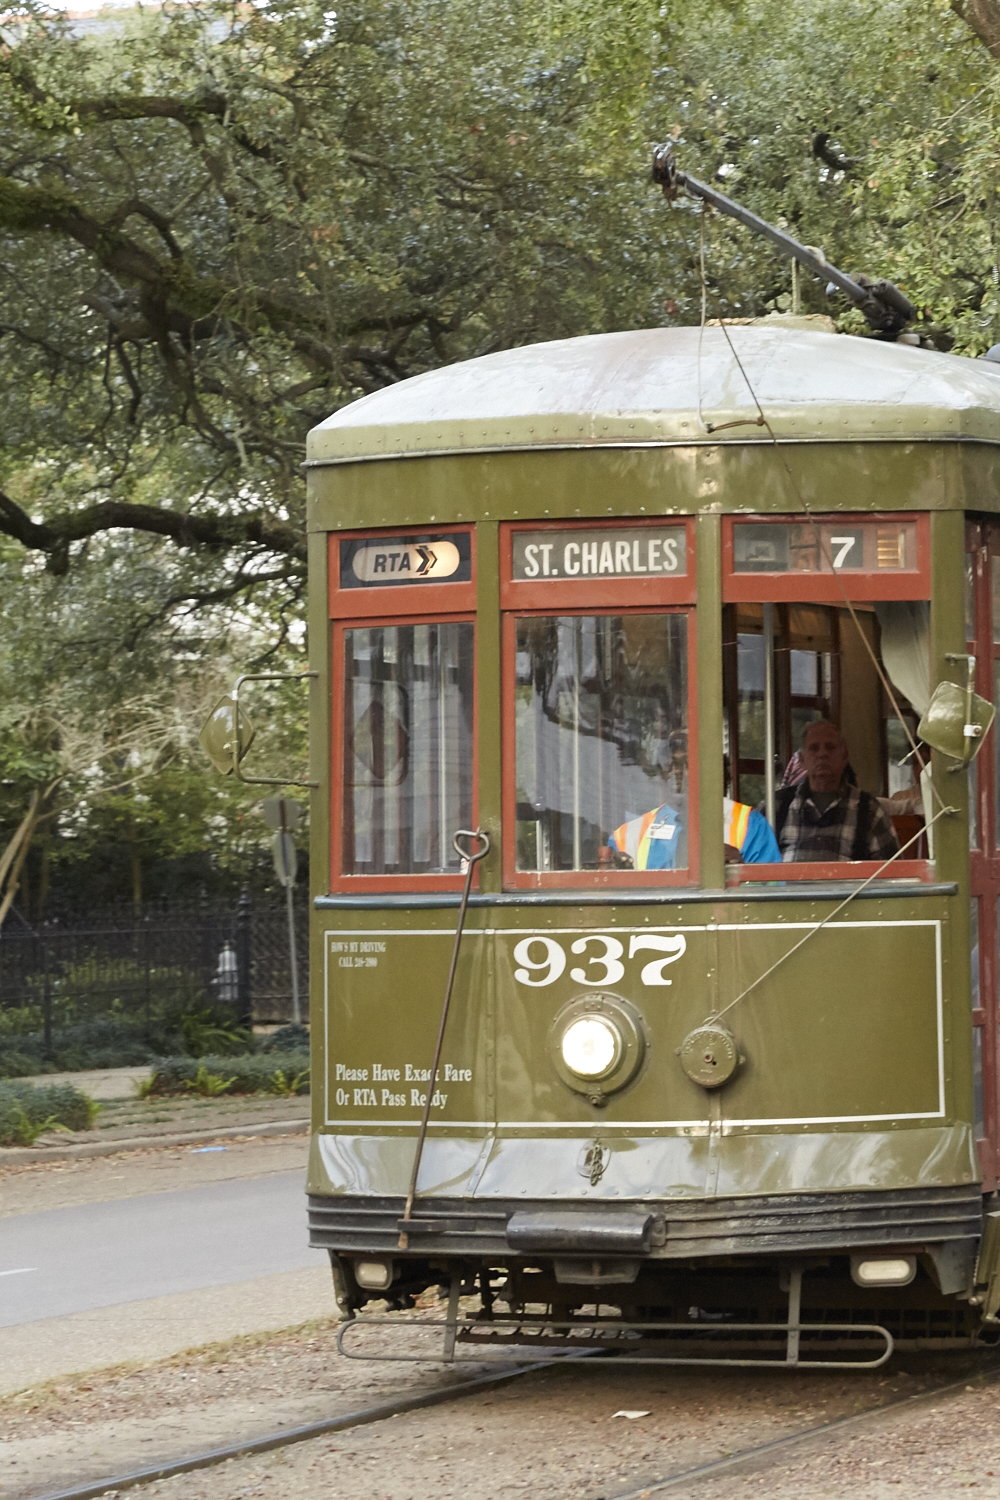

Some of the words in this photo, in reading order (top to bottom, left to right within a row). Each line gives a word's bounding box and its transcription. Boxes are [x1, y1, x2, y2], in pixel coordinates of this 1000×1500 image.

[373, 552, 411, 573] RTA
[524, 544, 558, 577] ST.
[564, 538, 678, 575] CHARLES
[830, 536, 855, 568] 7
[513, 934, 687, 987] 937
[335, 1063, 369, 1082] Please
[372, 1063, 400, 1082] Have
[444, 1063, 472, 1082] Fare
[335, 1087, 350, 1106] Or
[353, 1088, 378, 1106] RTA
[381, 1088, 407, 1106] Pass
[410, 1088, 448, 1110] Redy
